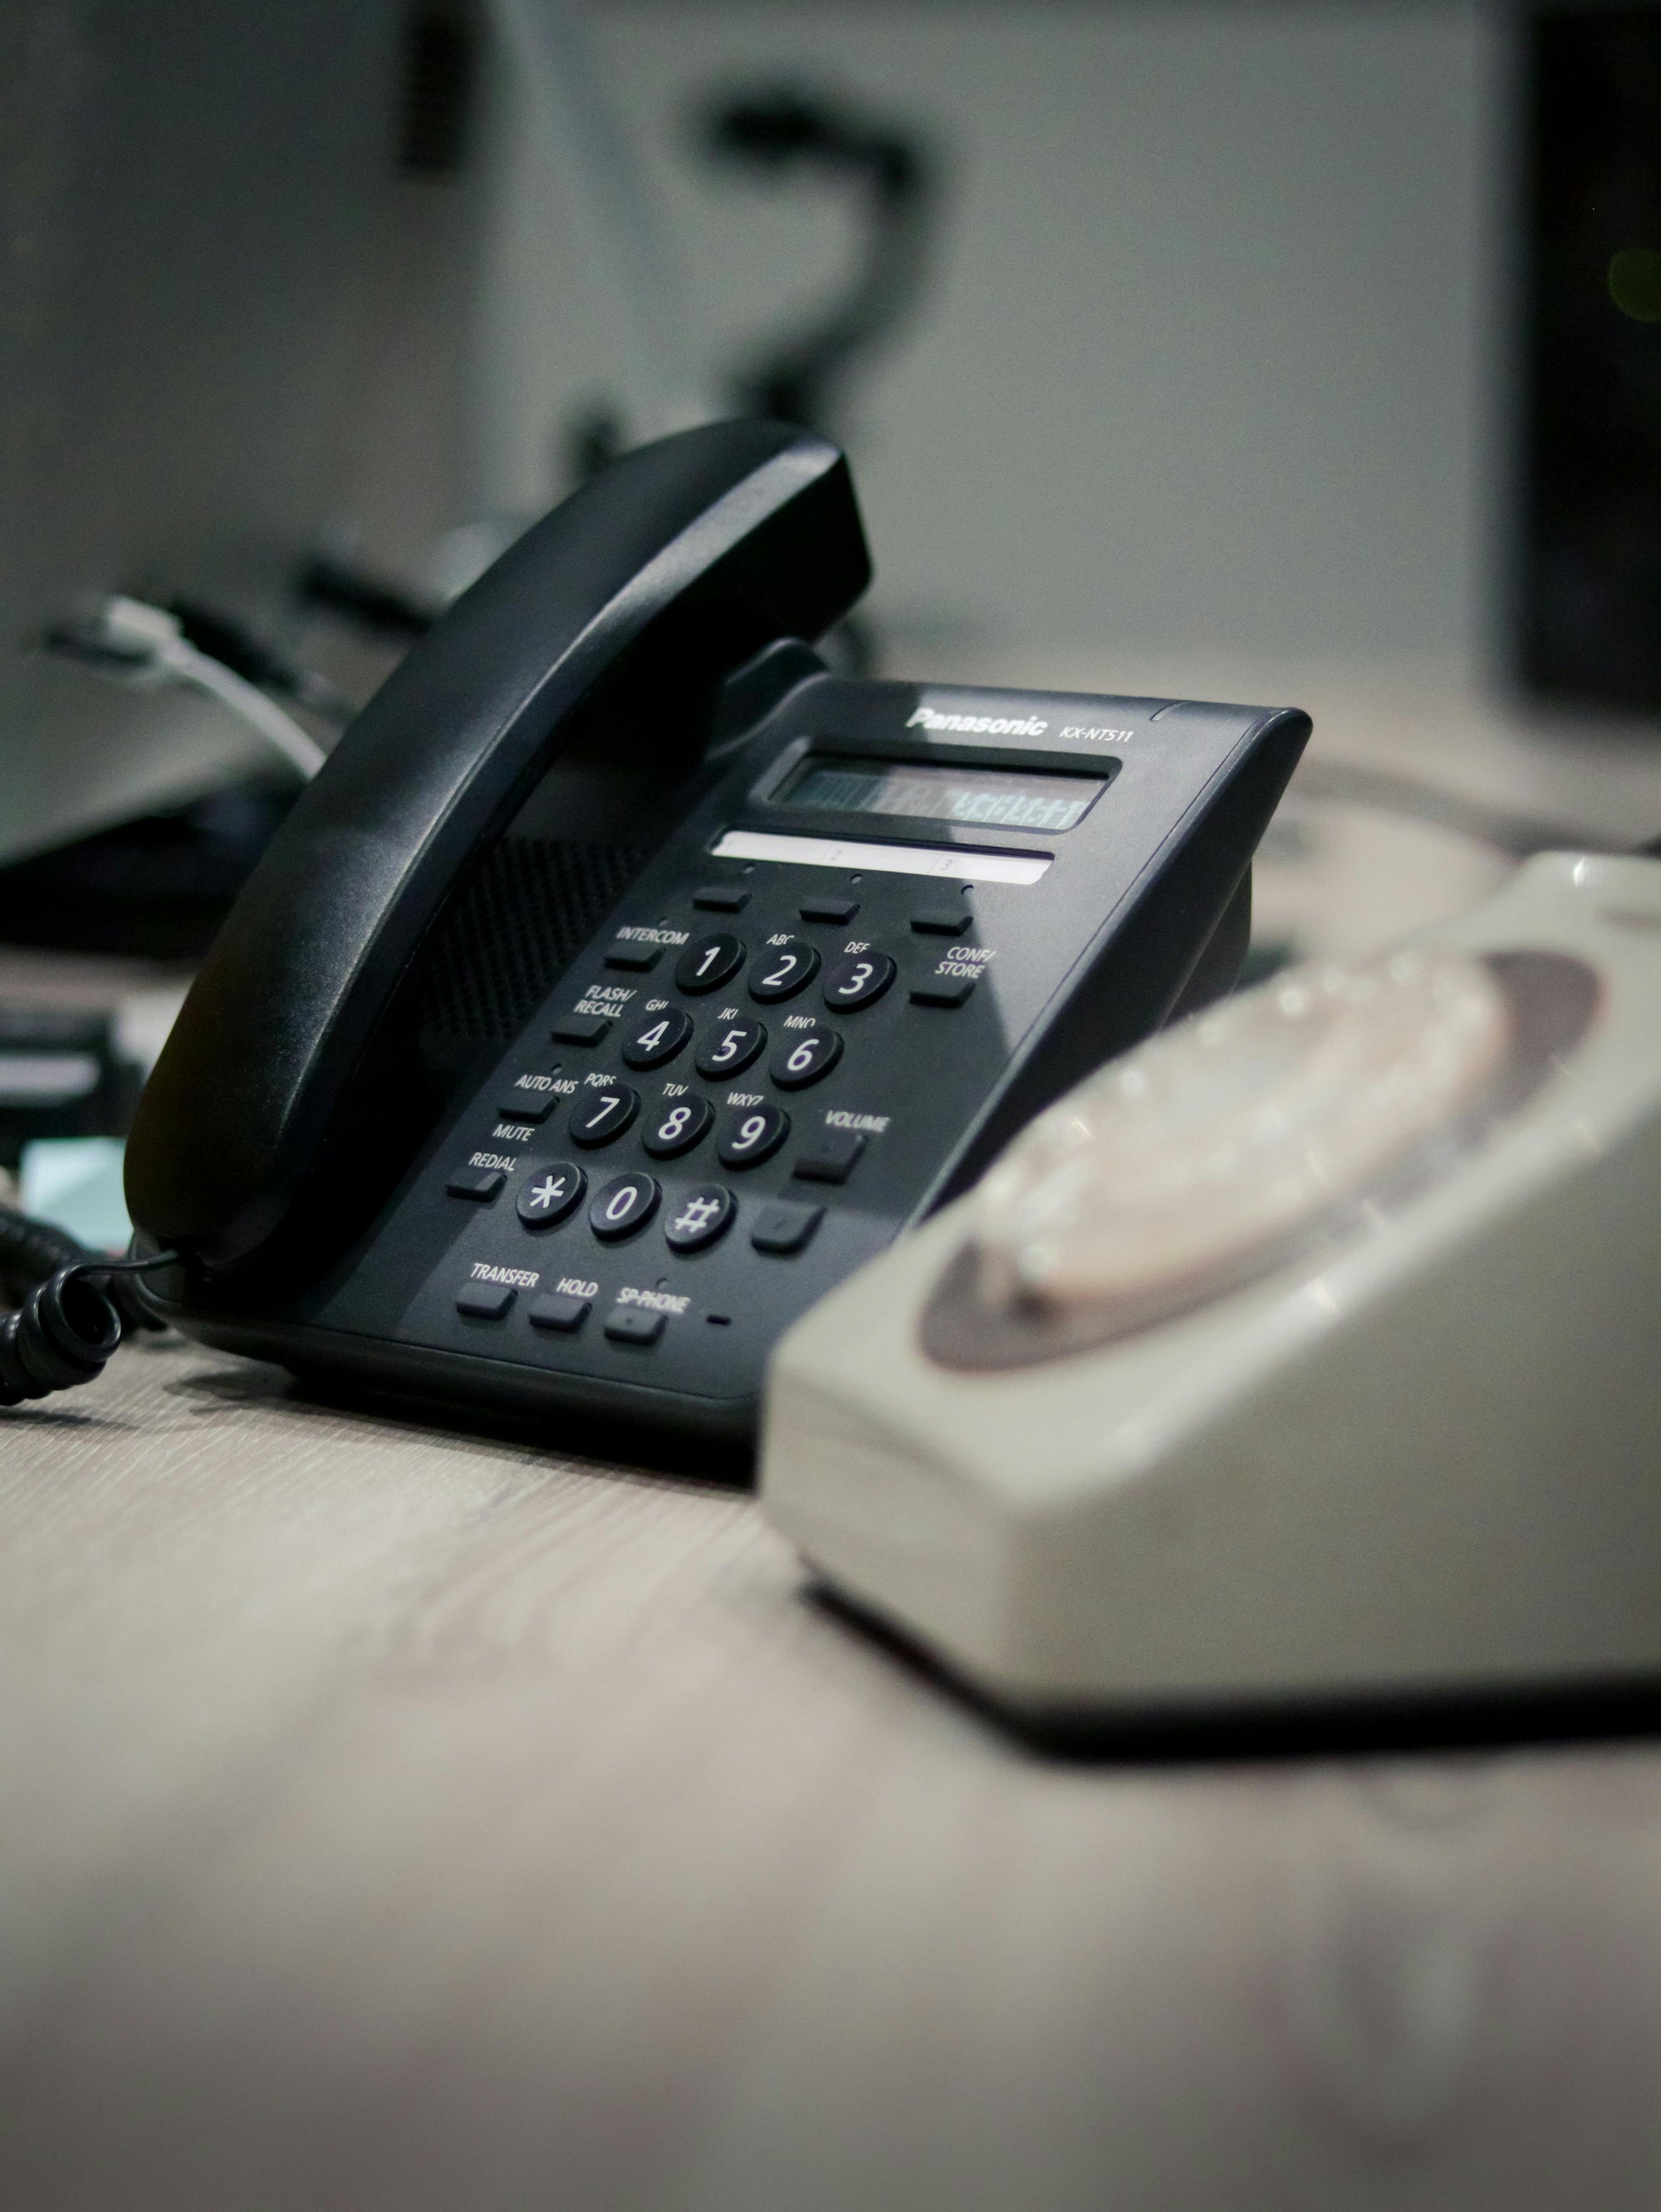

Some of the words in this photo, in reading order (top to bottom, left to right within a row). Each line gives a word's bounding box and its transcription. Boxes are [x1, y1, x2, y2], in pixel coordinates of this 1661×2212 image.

[905, 707, 1049, 737] Panasonic
[1058, 726, 1134, 743] KX-NT511
[940, 859, 953, 871] 3
[616, 926, 690, 946] INTERCOM
[766, 933, 796, 946] ABC
[844, 941, 870, 954] DEF
[946, 946, 997, 963] CONF/
[696, 946, 721, 976] 1
[762, 954, 797, 986] 2
[935, 961, 986, 980] STORE
[838, 962, 874, 995] 3
[584, 984, 638, 1002] FLASH/
[573, 999, 625, 1018] RECALL
[644, 999, 669, 1012] GHI
[636, 1020, 670, 1052] 4
[712, 1029, 747, 1062] 5
[786, 1038, 821, 1072] 6
[514, 1073, 552, 1092] AUTO
[549, 1078, 579, 1095] ANS
[661, 1082, 689, 1097] TUV
[585, 1096, 620, 1128] 7
[825, 1109, 892, 1133] VOLUME
[492, 1123, 536, 1142] MUTE
[658, 1106, 692, 1141] 8
[731, 1115, 767, 1151] 9
[468, 1151, 519, 1172] REDIAL
[605, 1186, 639, 1221] 0
[469, 1262, 541, 1288] TRANSFER
[556, 1277, 600, 1299] HOLD
[615, 1286, 691, 1315] SP-PHONE
